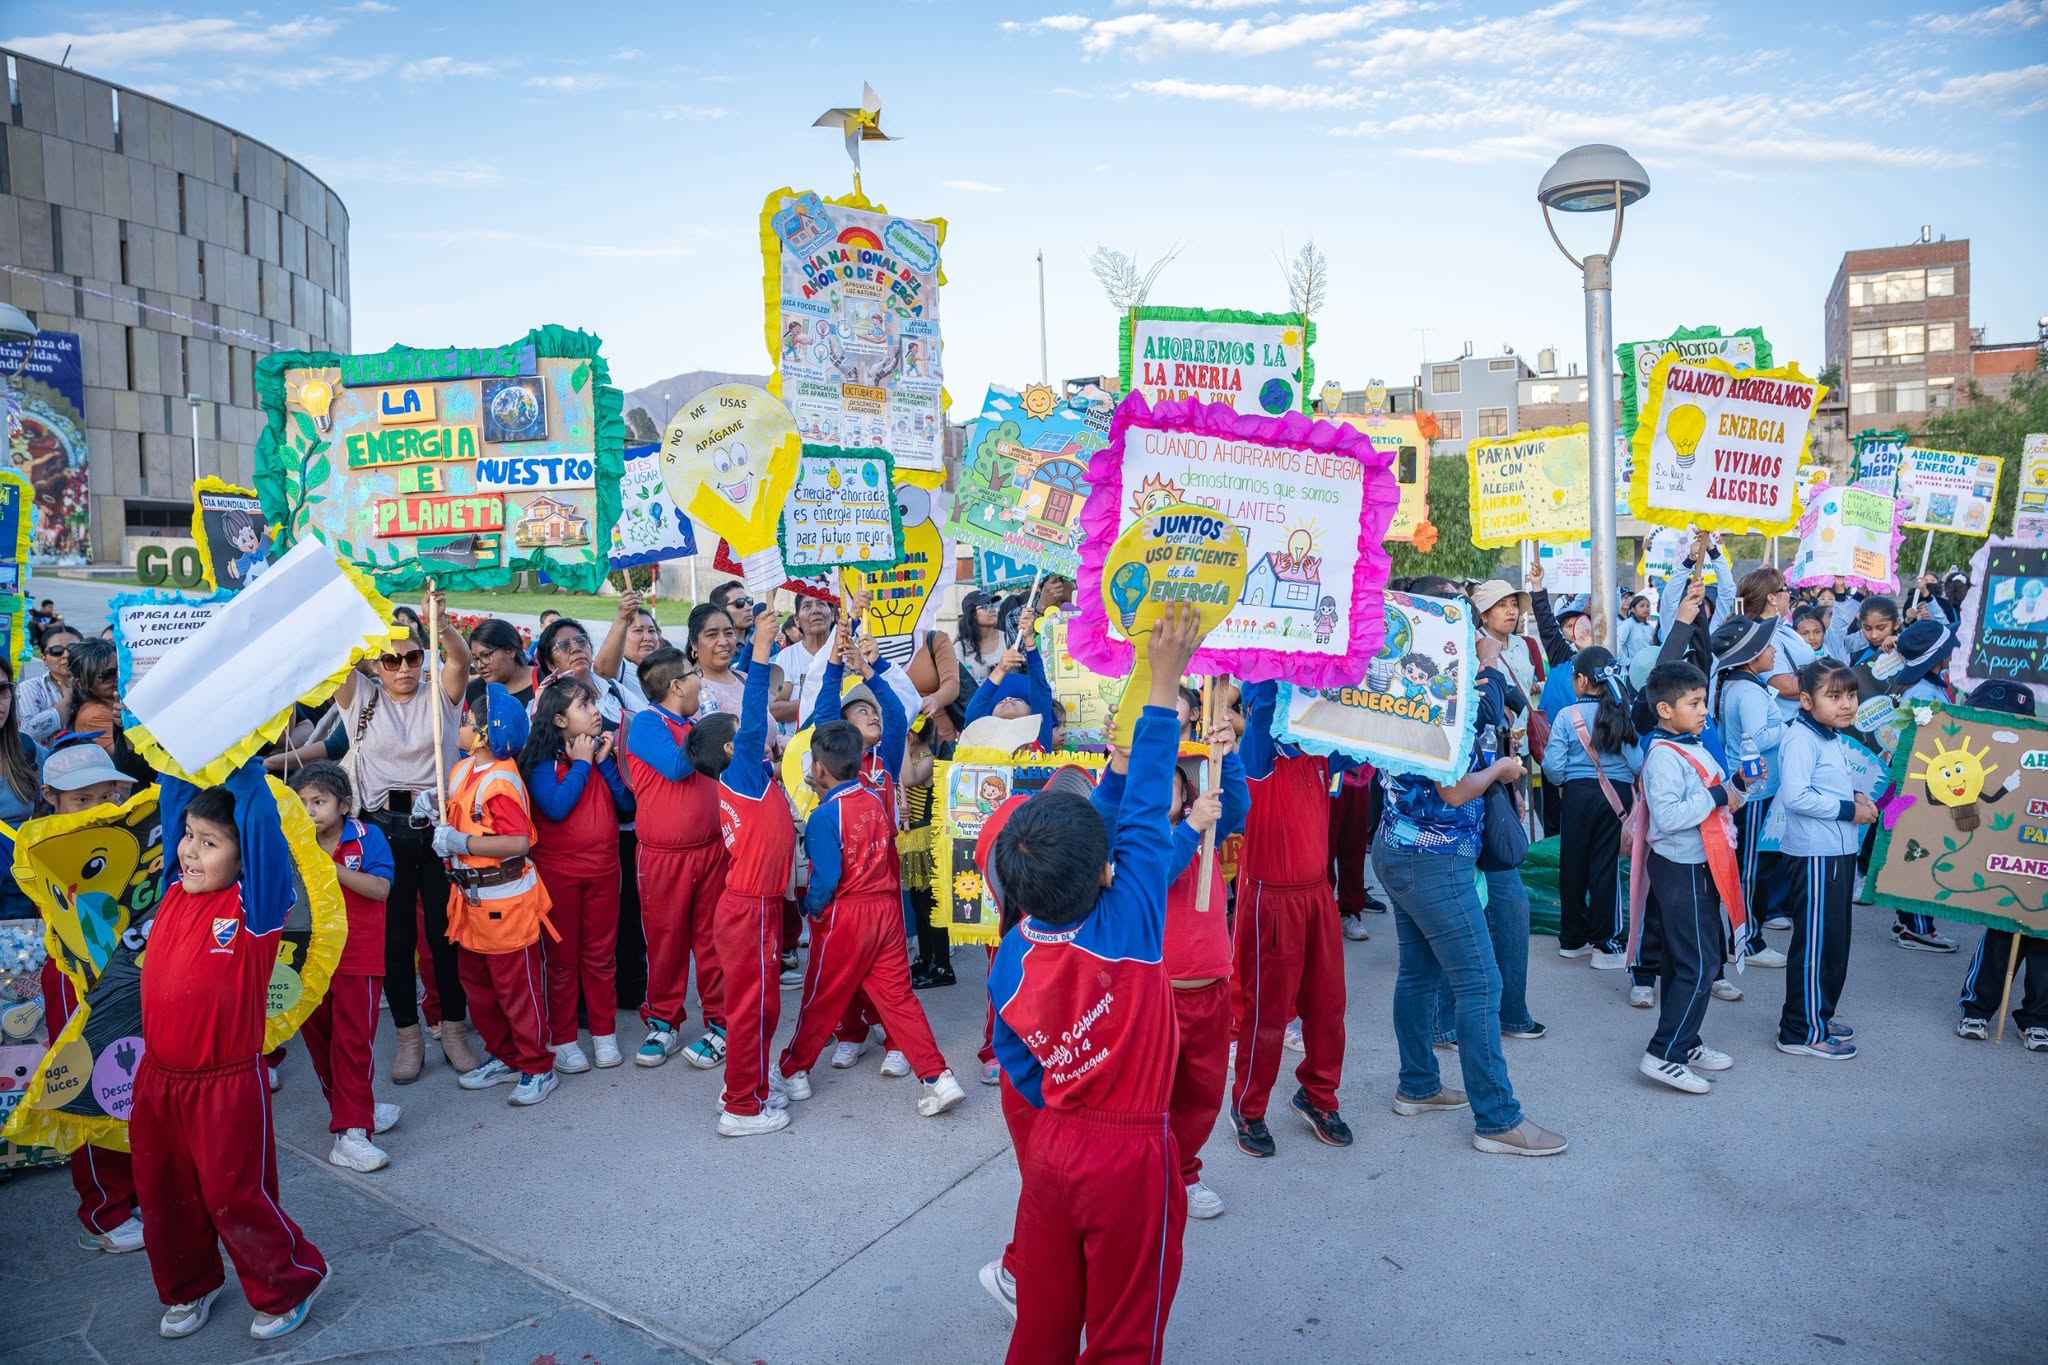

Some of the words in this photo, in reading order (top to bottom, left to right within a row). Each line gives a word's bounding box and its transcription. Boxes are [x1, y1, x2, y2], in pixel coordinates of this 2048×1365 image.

[802, 254, 828, 277] DÍA
[828, 249, 897, 274] NACIONAL
[899, 268, 923, 296] DEL
[802, 265, 853, 299] AHORRO
[857, 266, 873, 281] DE
[57, 339, 73, 351] de
[1143, 335, 1256, 366] AHORREMOS
[1263, 343, 1287, 367] LA
[341, 347, 522, 384] AHORREMOS
[1144, 362, 1167, 386] LA
[1174, 363, 1242, 391] ENERIA
[845, 387, 873, 398] OCTUBRE
[876, 390, 884, 400] 21
[1667, 366, 1725, 398] CUANDO
[1726, 377, 1813, 411] AHORRAMOS
[382, 389, 421, 415] LA
[690, 404, 707, 420] ME
[720, 397, 747, 409] USAS
[671, 428, 684, 446] NO
[695, 420, 744, 453] APÁGAME
[1718, 413, 1785, 444] ENERGIA
[346, 427, 475, 467] ENERGIA
[1145, 433, 1208, 461] CUANDO
[1213, 443, 1301, 473] AHORRAMOS
[1304, 455, 1362, 482] ENERGIA
[1476, 446, 1512, 466] PARA
[1512, 441, 1546, 460] VIVIR
[666, 453, 677, 464] SI
[1714, 449, 1782, 479] VIVIMOS
[1911, 450, 1956, 464] AHORRO
[1962, 455, 1979, 467] DE
[1915, 461, 1967, 476] ENERGIA
[399, 465, 434, 491] DE
[476, 457, 593, 485] NUESTRO
[1500, 462, 1523, 477] CON
[1179, 463, 1270, 495] demostramos
[1273, 481, 1296, 500] que
[1301, 486, 1340, 504] somos
[1482, 480, 1525, 494] ALEGRIA
[1706, 475, 1779, 507] ALEGRES
[203, 498, 216, 506] DIA
[217, 499, 248, 509] MUNDIAL
[840, 487, 885, 502] ahorrada
[1481, 495, 1523, 511] AHORRA
[379, 497, 503, 532] PLANETA
[793, 508, 808, 520] es
[796, 532, 817, 547] para
[822, 527, 851, 544] futuro
[856, 528, 884, 547] mejor
[1152, 515, 1224, 540] JUNTOS
[1165, 534, 1186, 545] por
[1188, 535, 1204, 545] un
[1146, 546, 1173, 563] USO
[1175, 546, 1239, 567] EFICIENTE
[881, 569, 926, 583] AHORRO
[1167, 566, 1180, 578] de
[1182, 566, 1196, 578] la
[1150, 580, 1231, 605] ENERGÍA
[125, 611, 170, 622] ¡APAGA
[191, 610, 212, 618] LUZ
[140, 624, 147, 632] Y
[1982, 626, 2039, 649] Enciende
[1974, 649, 2030, 676] Apaga
[2023, 826, 2048, 844] PA
[47, 1075, 79, 1093] luces
